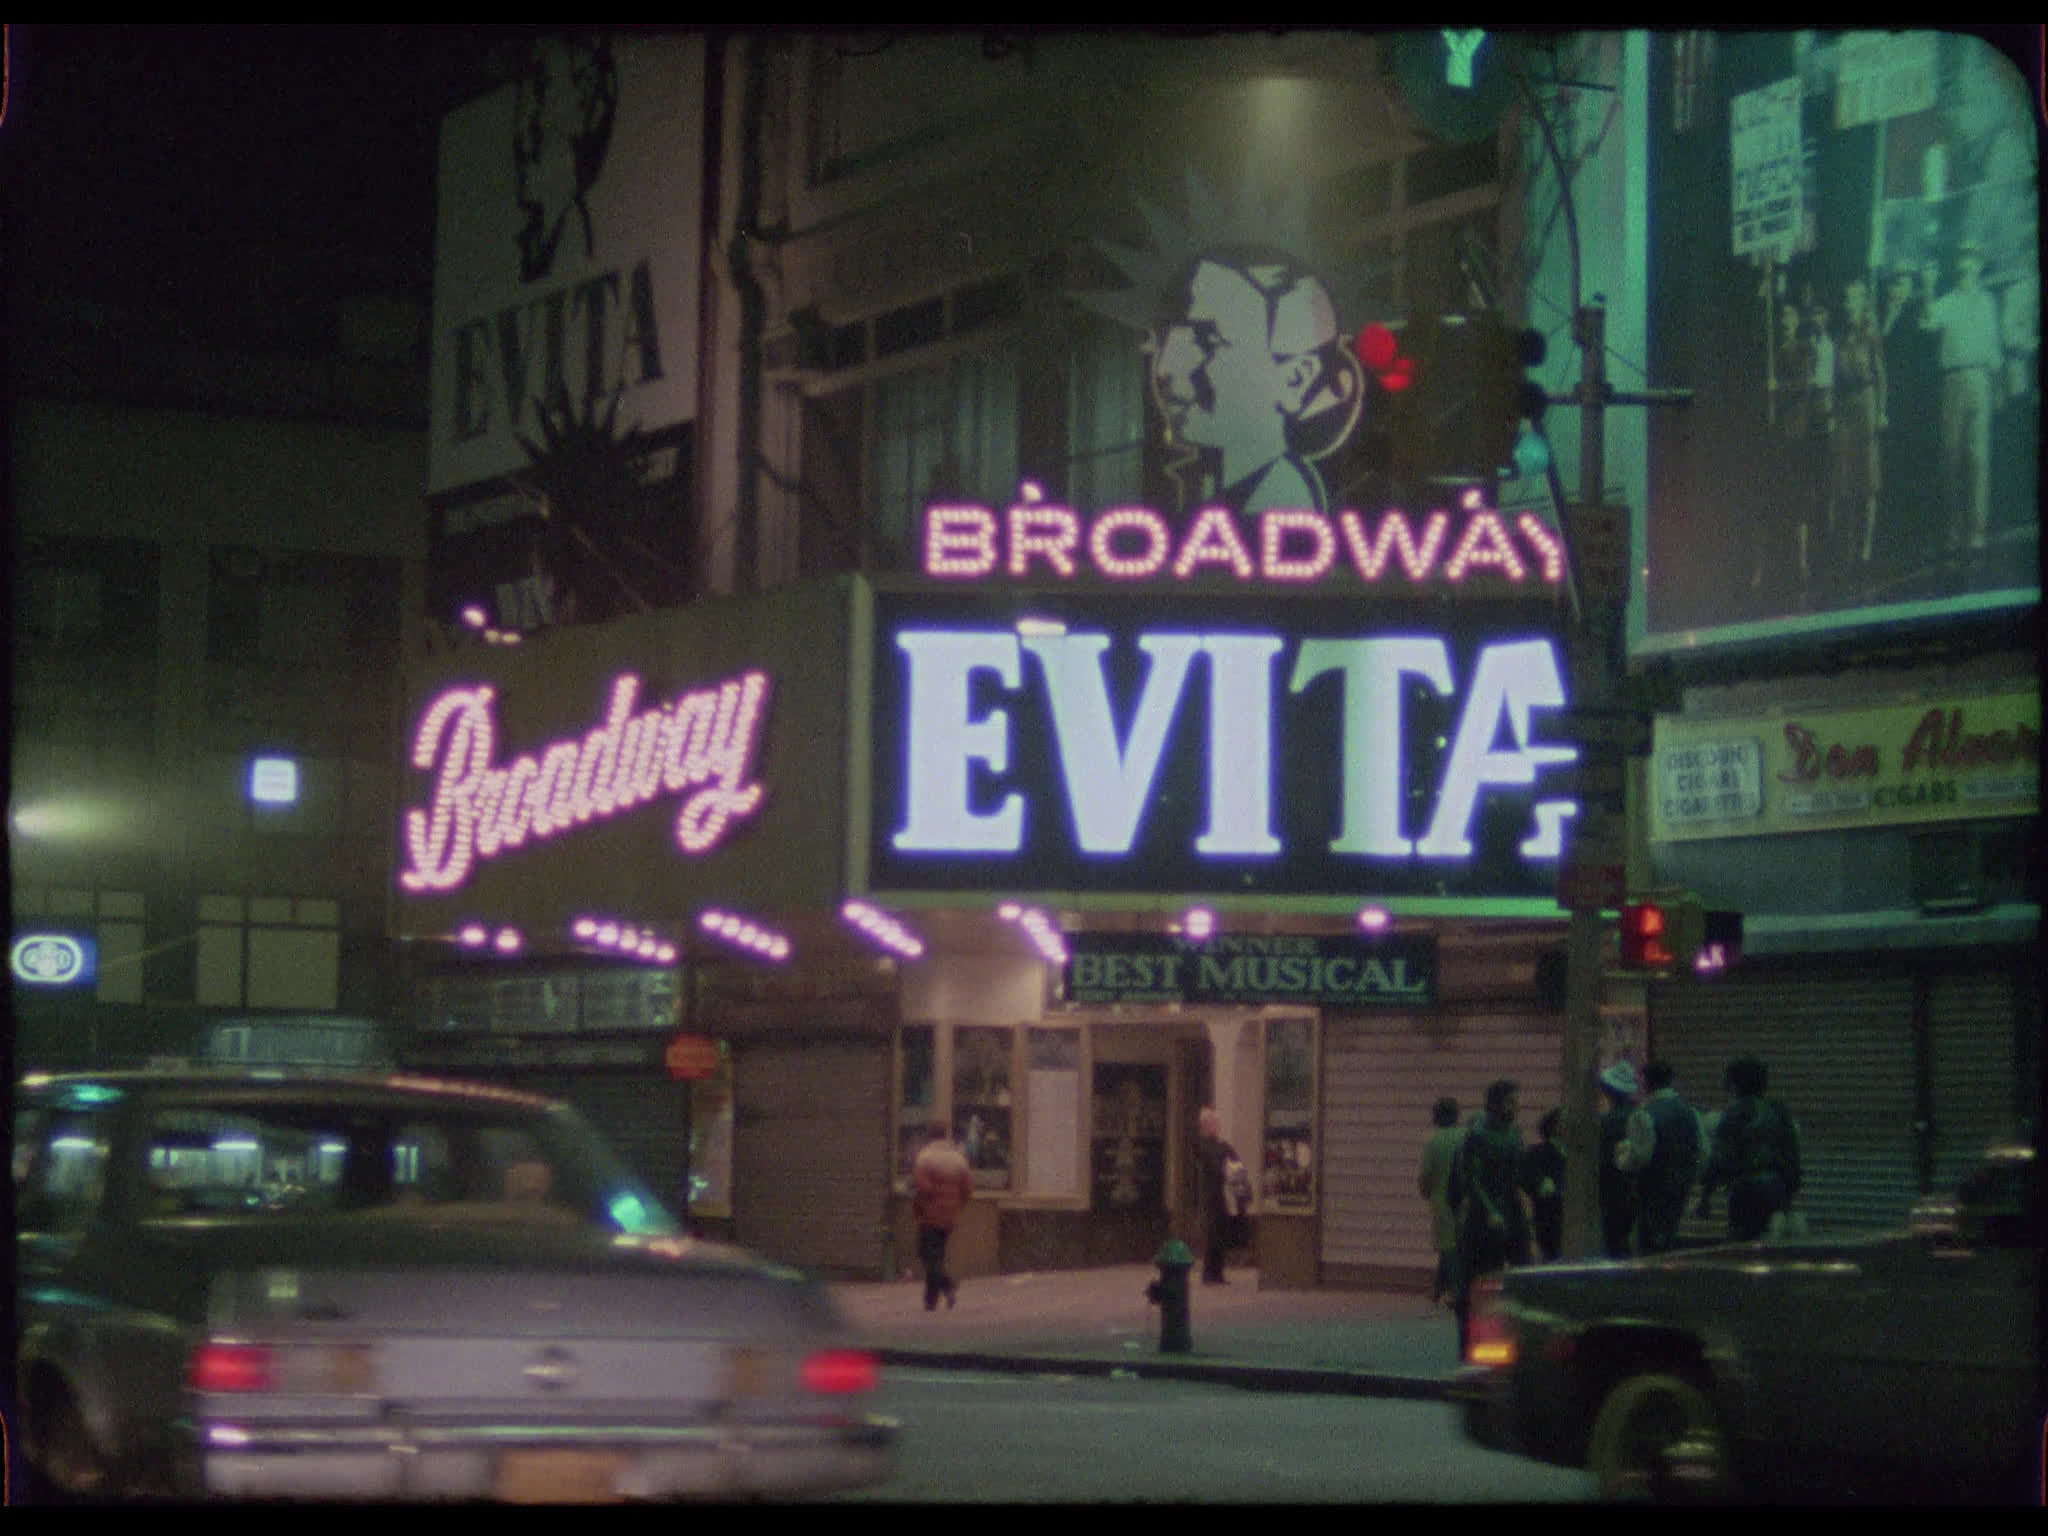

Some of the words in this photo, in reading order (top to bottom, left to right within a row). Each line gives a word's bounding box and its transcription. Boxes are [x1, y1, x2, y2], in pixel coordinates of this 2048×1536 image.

[453, 257, 664, 443] EVITA
[400, 671, 767, 893] Broadway
[893, 631, 1578, 858] EVITA
[1874, 779, 1958, 807] CIGARS
[1071, 953, 1183, 988] BEST
[1198, 955, 1427, 993] MUSICAL
[1175, 936, 1319, 955] WINNER
